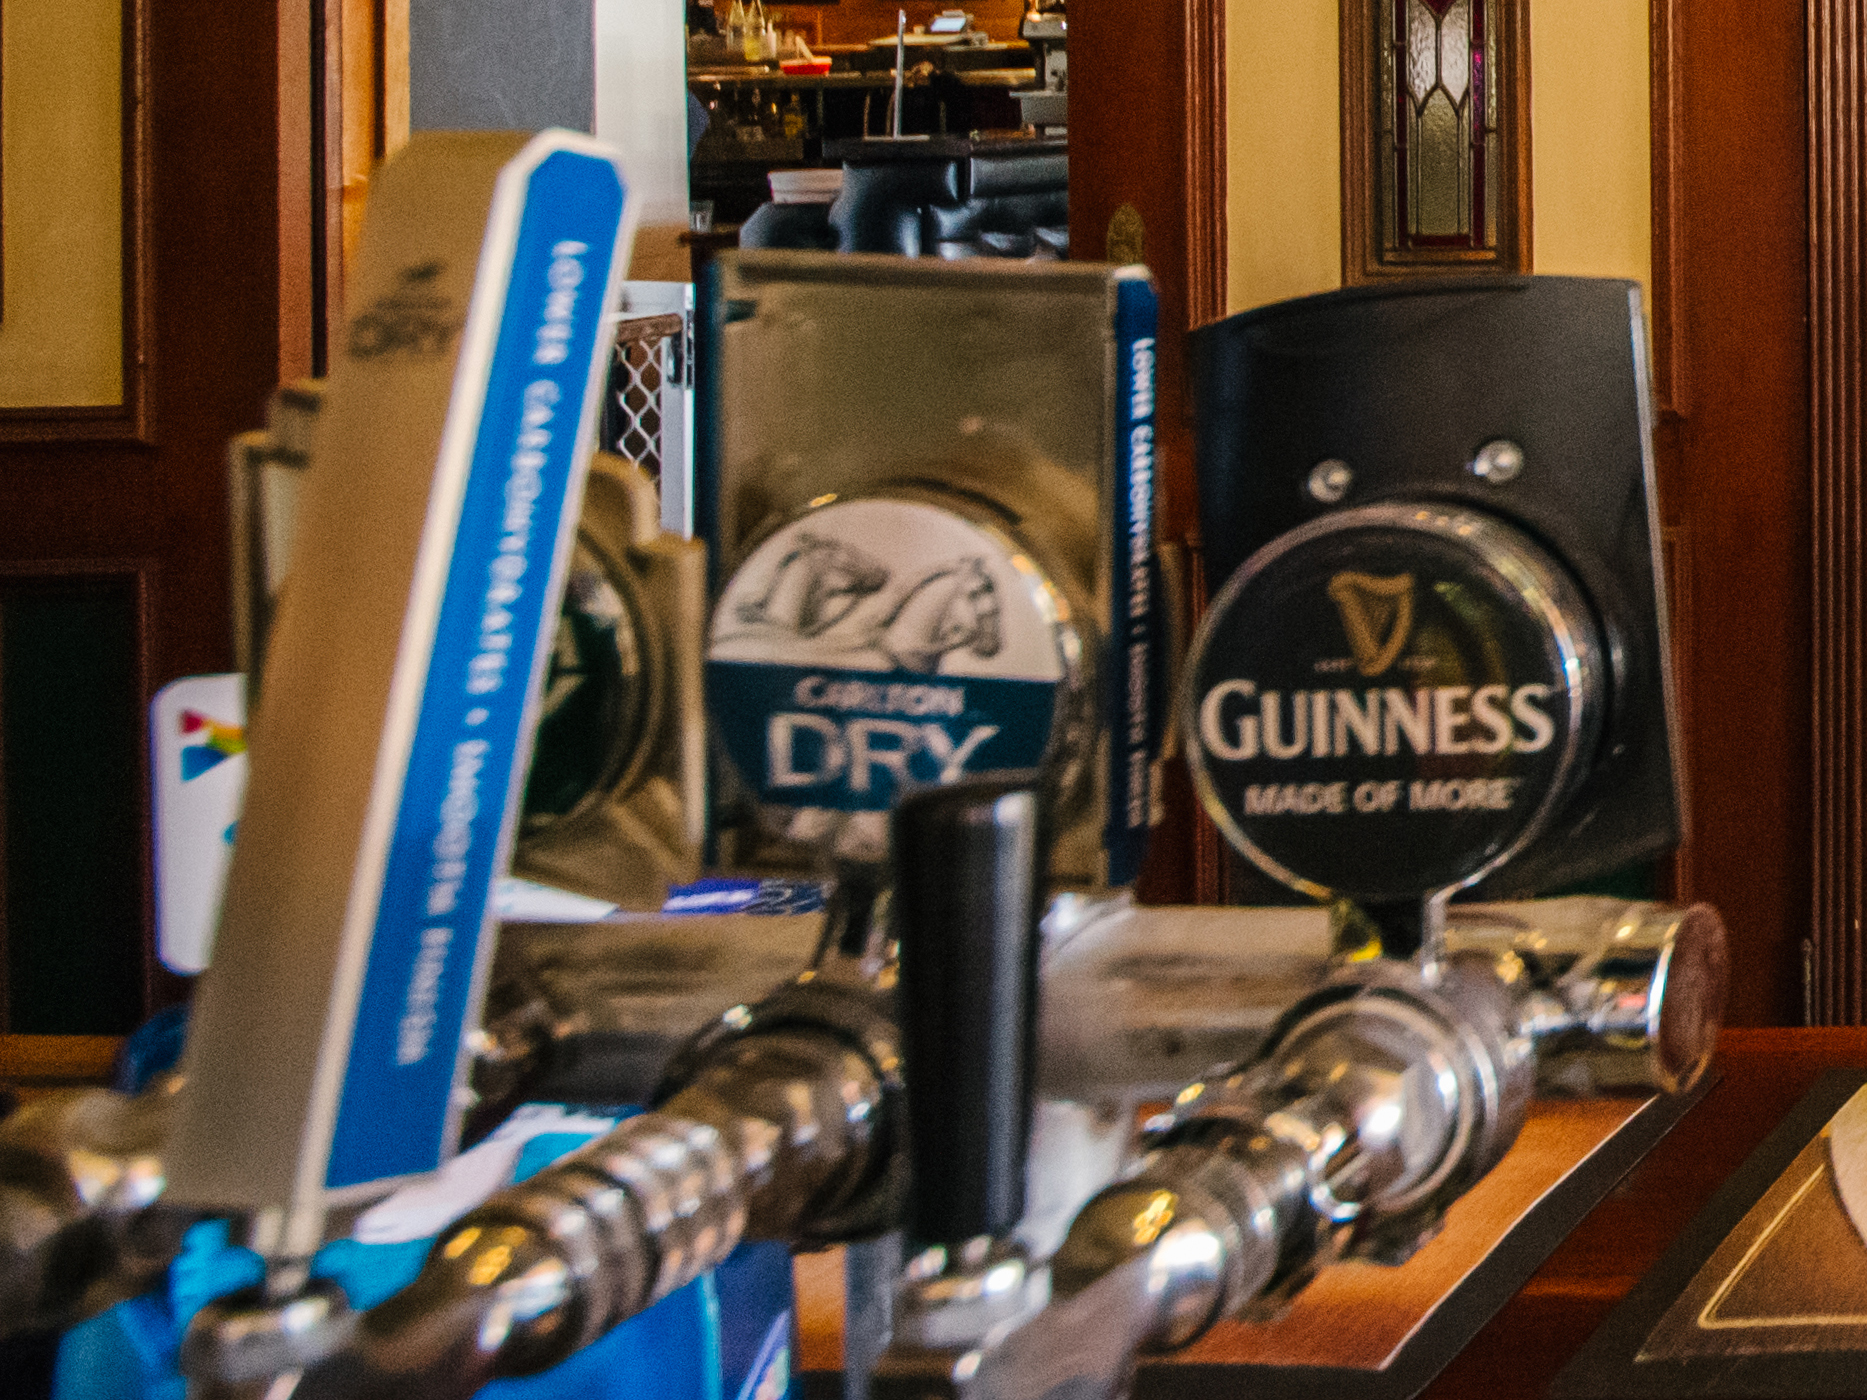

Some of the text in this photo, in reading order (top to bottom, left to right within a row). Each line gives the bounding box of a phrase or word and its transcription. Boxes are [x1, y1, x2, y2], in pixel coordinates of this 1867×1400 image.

[532, 239, 590, 366] LOWER
[1130, 337, 1156, 420] LOWER
[465, 381, 562, 693] CARBOHYDRATES
[794, 675, 968, 717] CARLTON
[1201, 679, 1556, 763] GUINNESS
[766, 712, 1000, 793] DRY
[1244, 777, 1518, 815] MADE OF MORE
